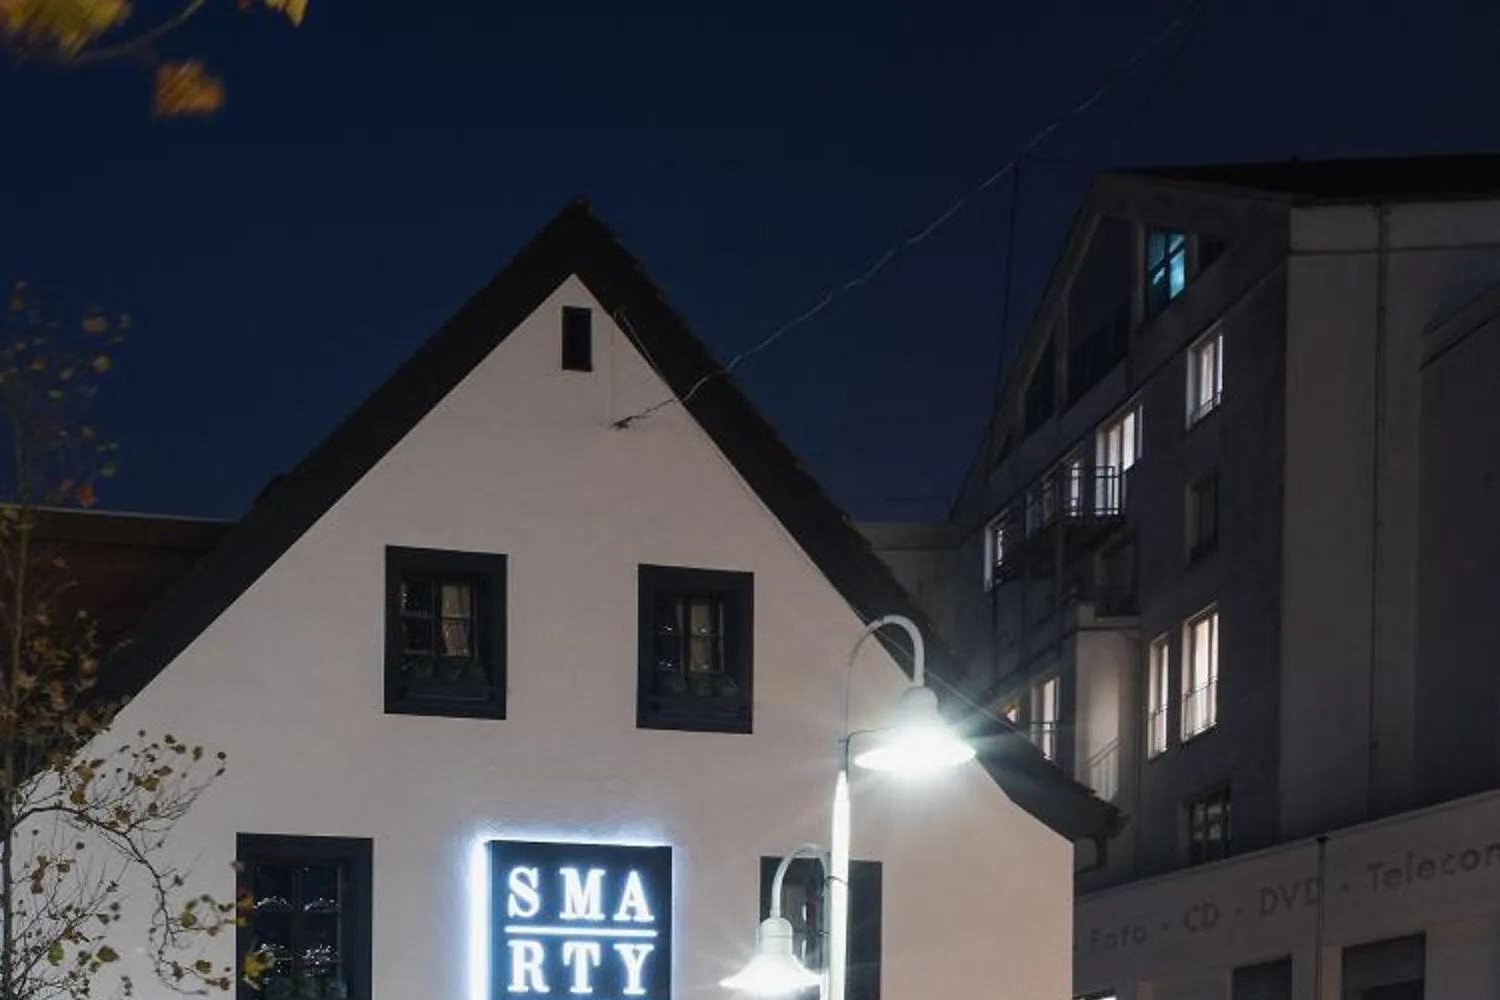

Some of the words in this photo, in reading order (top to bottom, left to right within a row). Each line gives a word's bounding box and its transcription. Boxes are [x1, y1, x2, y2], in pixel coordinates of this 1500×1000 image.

[508, 866, 655, 922] SMA
[1183, 899, 1221, 932] CD
[1258, 876, 1325, 917] DVD
[507, 939, 655, 995] RTY
